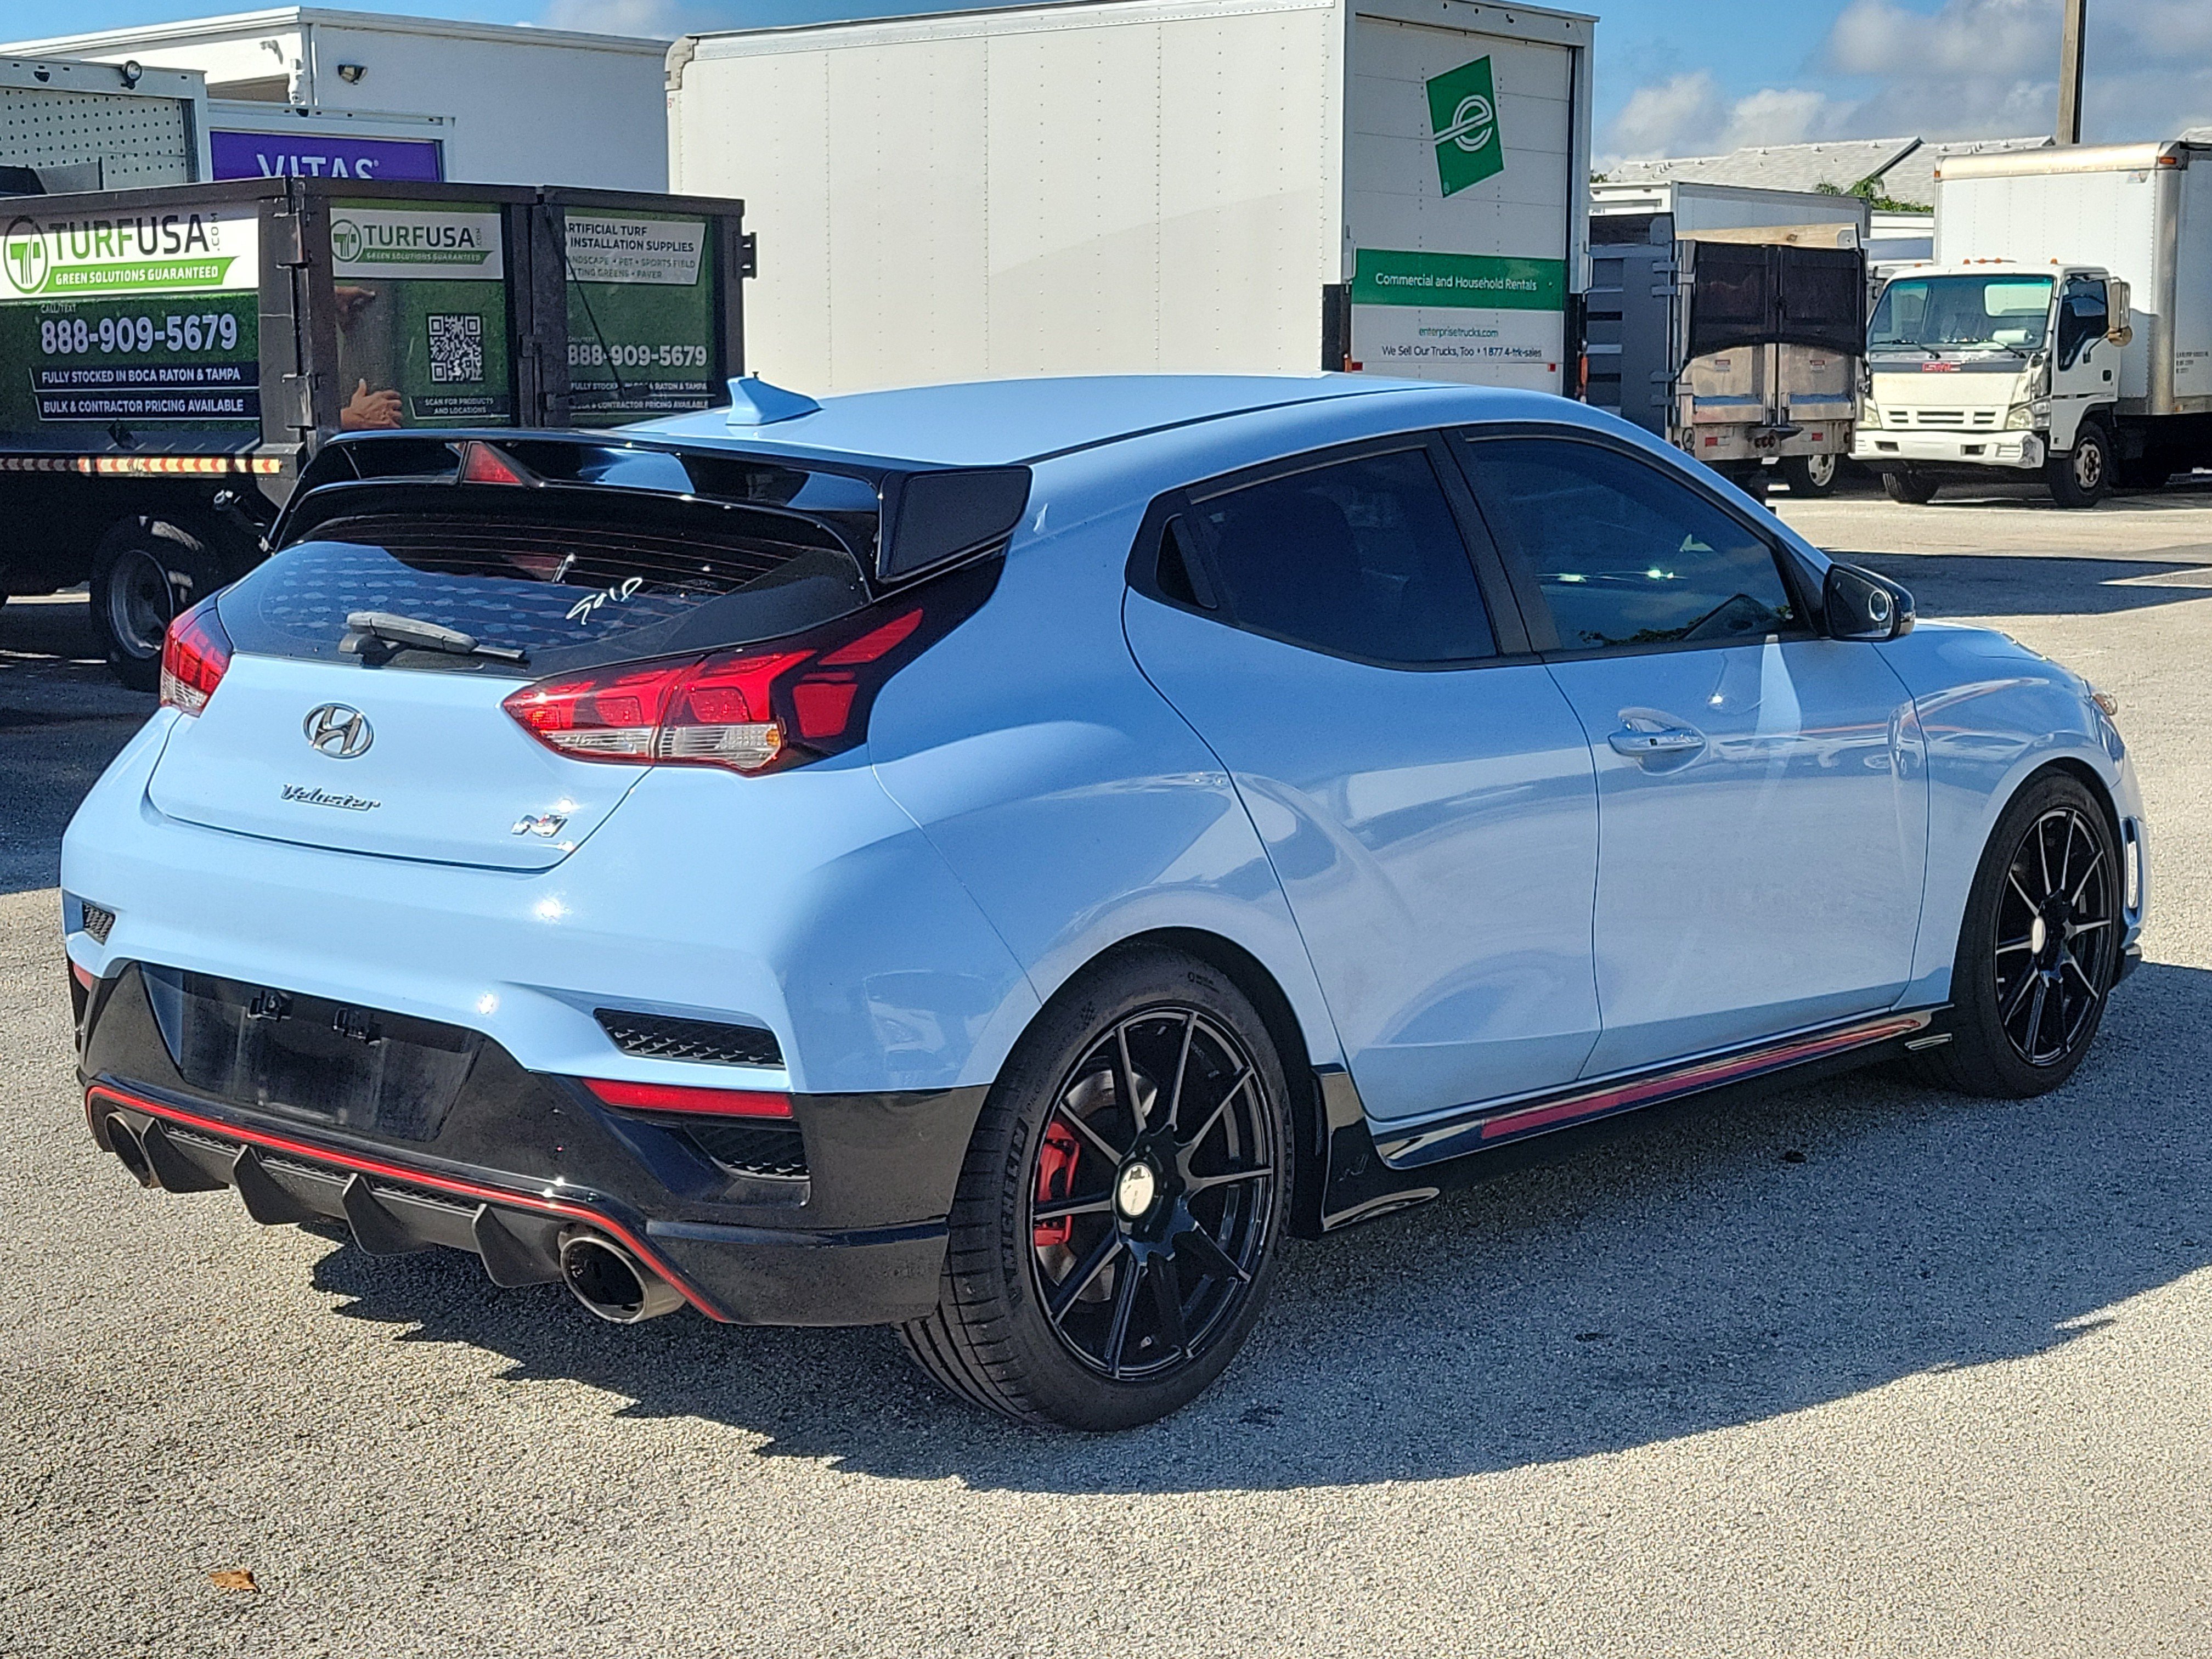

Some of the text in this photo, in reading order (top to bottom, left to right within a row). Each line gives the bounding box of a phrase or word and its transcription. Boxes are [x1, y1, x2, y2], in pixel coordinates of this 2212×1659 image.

[257, 154, 374, 179] VITAS
[49, 214, 210, 260] TURFUSA
[363, 225, 475, 247] TURFUSA
[567, 223, 647, 236] RTIFICIAL TURF
[571, 237, 694, 252] INSTALLATION SUPPLIES
[640, 258, 672, 267] SPORTS
[673, 259, 695, 268] FIELD
[56, 265, 218, 286] GREEN SOLUTIONS GUARANTEED
[1375, 273, 1537, 291] Commercial and Household Rentals
[42, 313, 237, 354] 888-909-5679
[1419, 326, 1499, 338] enterprisetrucks.com
[568, 345, 707, 366] 888-909-5679
[1381, 346, 1396, 356] We
[1398, 346, 1412, 356] Sell
[1414, 346, 1430, 356] Our
[1430, 346, 1459, 357] Trucks,
[1460, 346, 1474, 356] Too
[42, 367, 241, 383] FULLY STOCKED IN BOCA RATON & TAMPA
[44, 399, 243, 413] BULK & CONTRACTOR PRICING AVAILABLE
